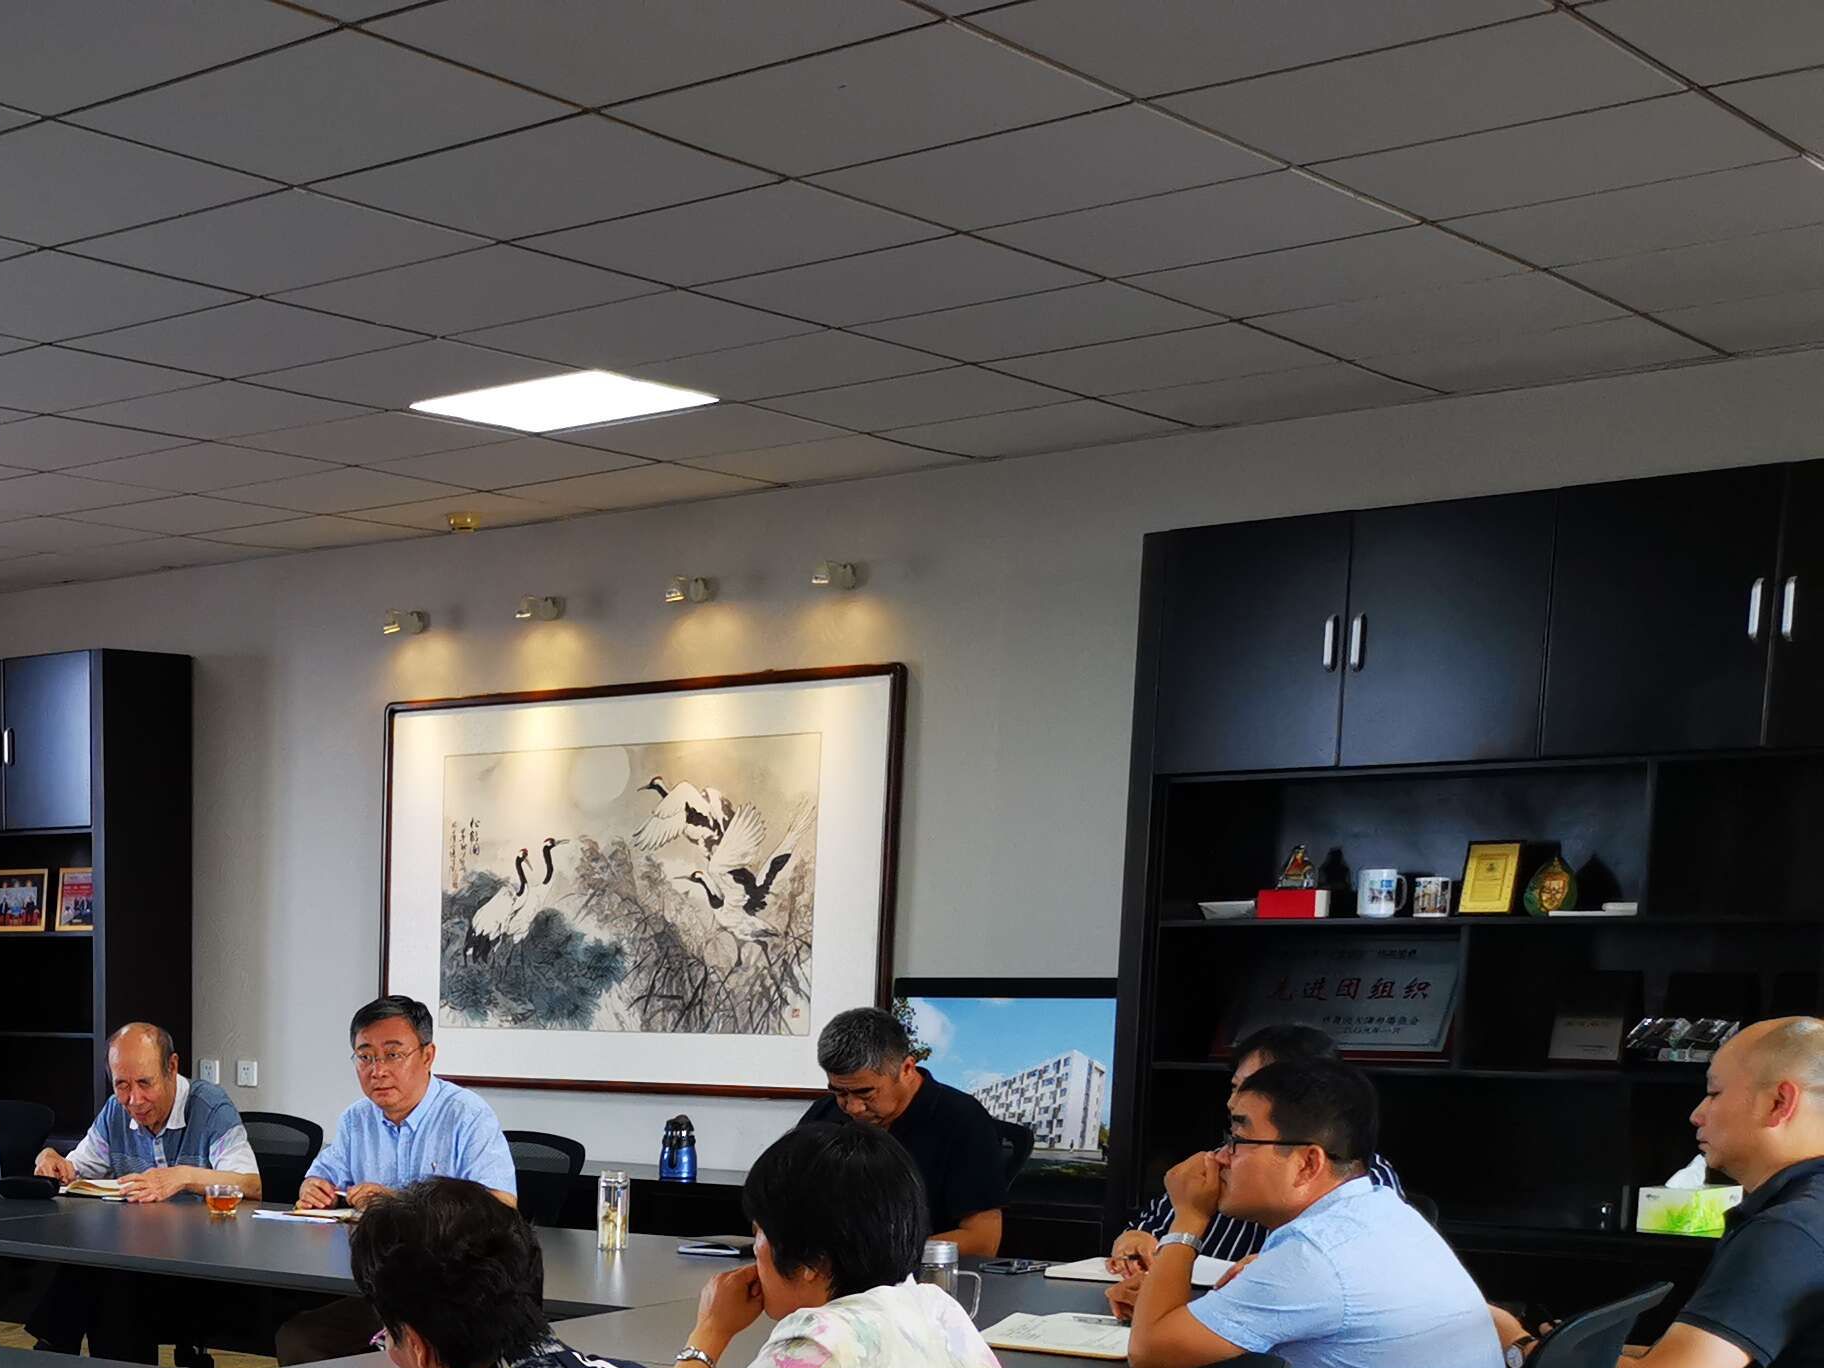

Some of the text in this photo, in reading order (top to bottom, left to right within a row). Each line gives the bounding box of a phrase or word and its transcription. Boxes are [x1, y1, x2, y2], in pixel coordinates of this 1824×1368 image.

[1264, 976, 1433, 1001] 先进团组织
